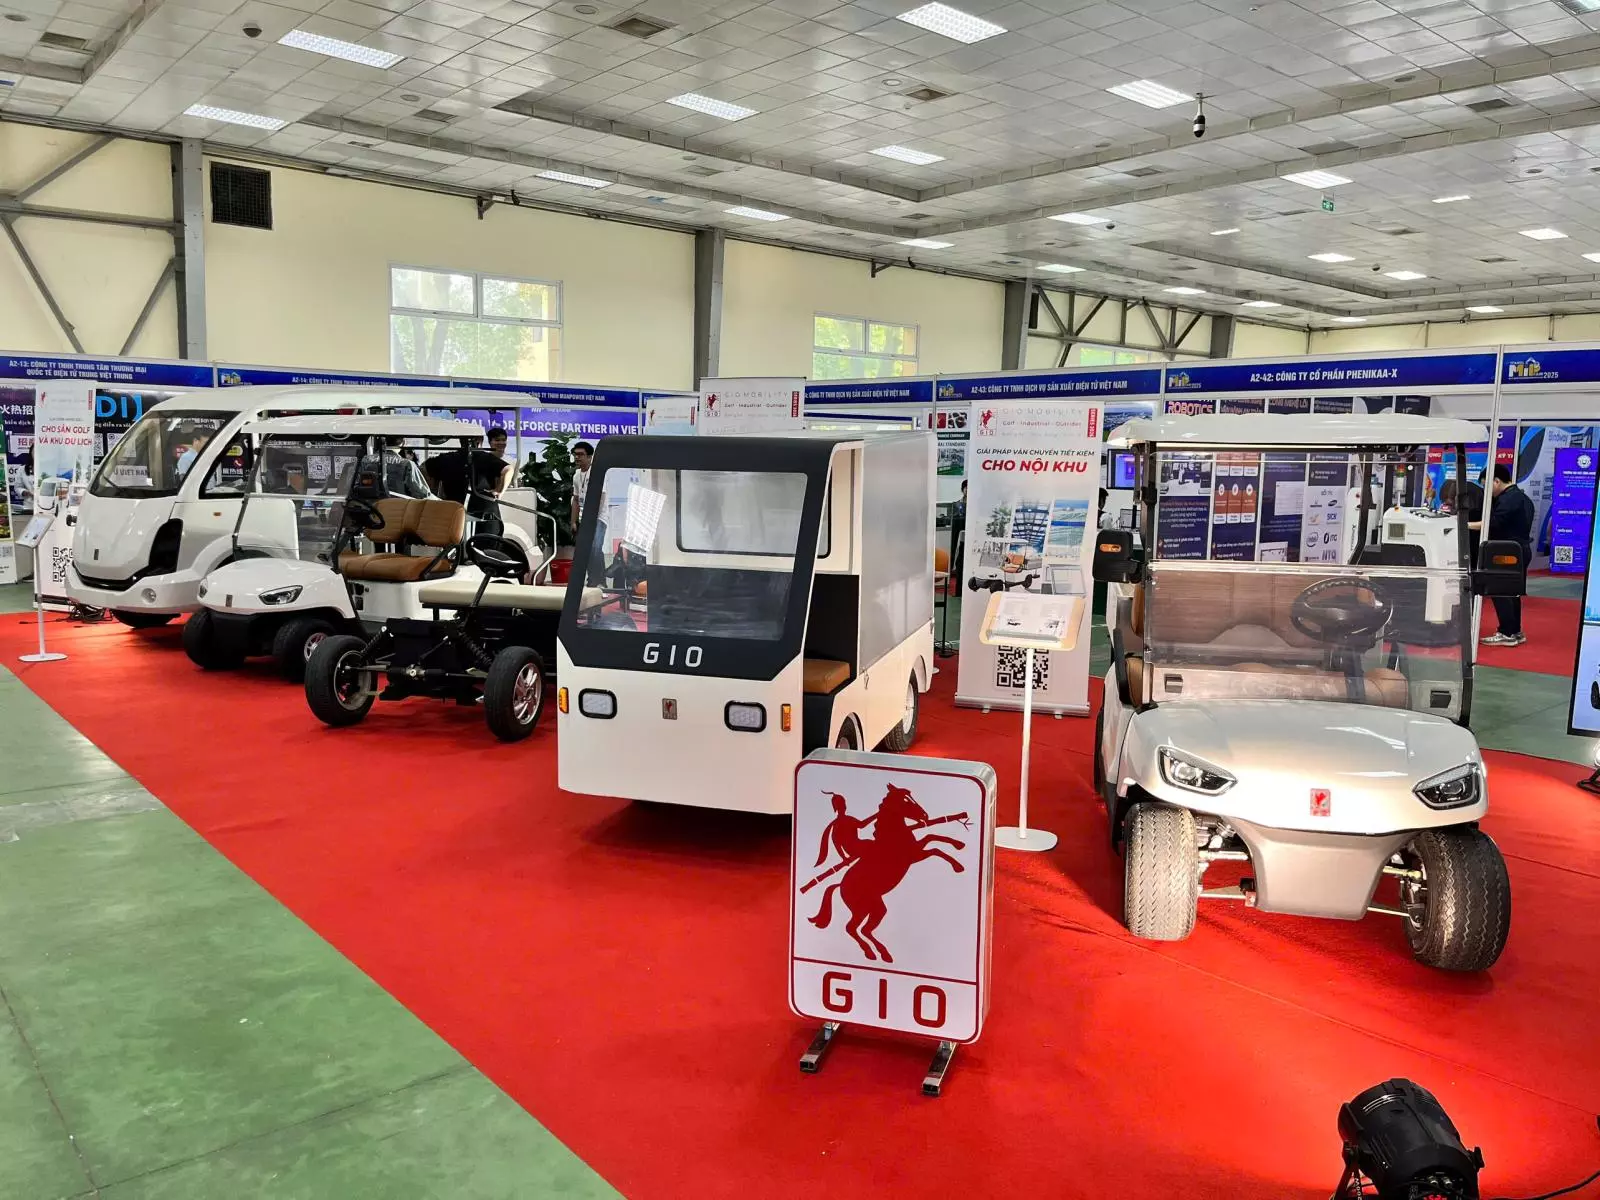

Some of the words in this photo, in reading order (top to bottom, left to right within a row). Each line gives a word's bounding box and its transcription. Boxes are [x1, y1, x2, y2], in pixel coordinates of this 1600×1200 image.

[1250, 373, 1274, 382] A2-42:
[1275, 370, 1297, 382] CÔNG
[1298, 371, 1309, 381] TY
[1309, 368, 1321, 381] CỔ
[1346, 368, 1398, 380] PHENIKAA-X
[987, 384, 1002, 393] CÔNG
[1003, 385, 1009, 393] TY
[1010, 384, 1025, 393] TNHH
[1025, 384, 1037, 393] DỊCH
[1038, 384, 1046, 393] VỤ
[1059, 380, 1075, 391] XUẤT
[1099, 380, 1112, 390] VIỆT
[1112, 380, 1128, 389] NAM
[1167, 401, 1213, 415] ROBOTICS
[41, 425, 56, 433] CHO
[56, 423, 71, 433] SÂN
[72, 426, 91, 434] GOLF
[560, 422, 608, 434] PARTNER
[609, 424, 619, 434] IN
[50, 437, 64, 445] KHU
[64, 437, 76, 445] DU
[992, 447, 1012, 455] PHÁP
[982, 459, 1016, 471] CHO
[1019, 457, 1049, 475] NỘI
[1052, 460, 1088, 473] KHU
[642, 642, 704, 668] GIO
[821, 970, 947, 1029] GIO
